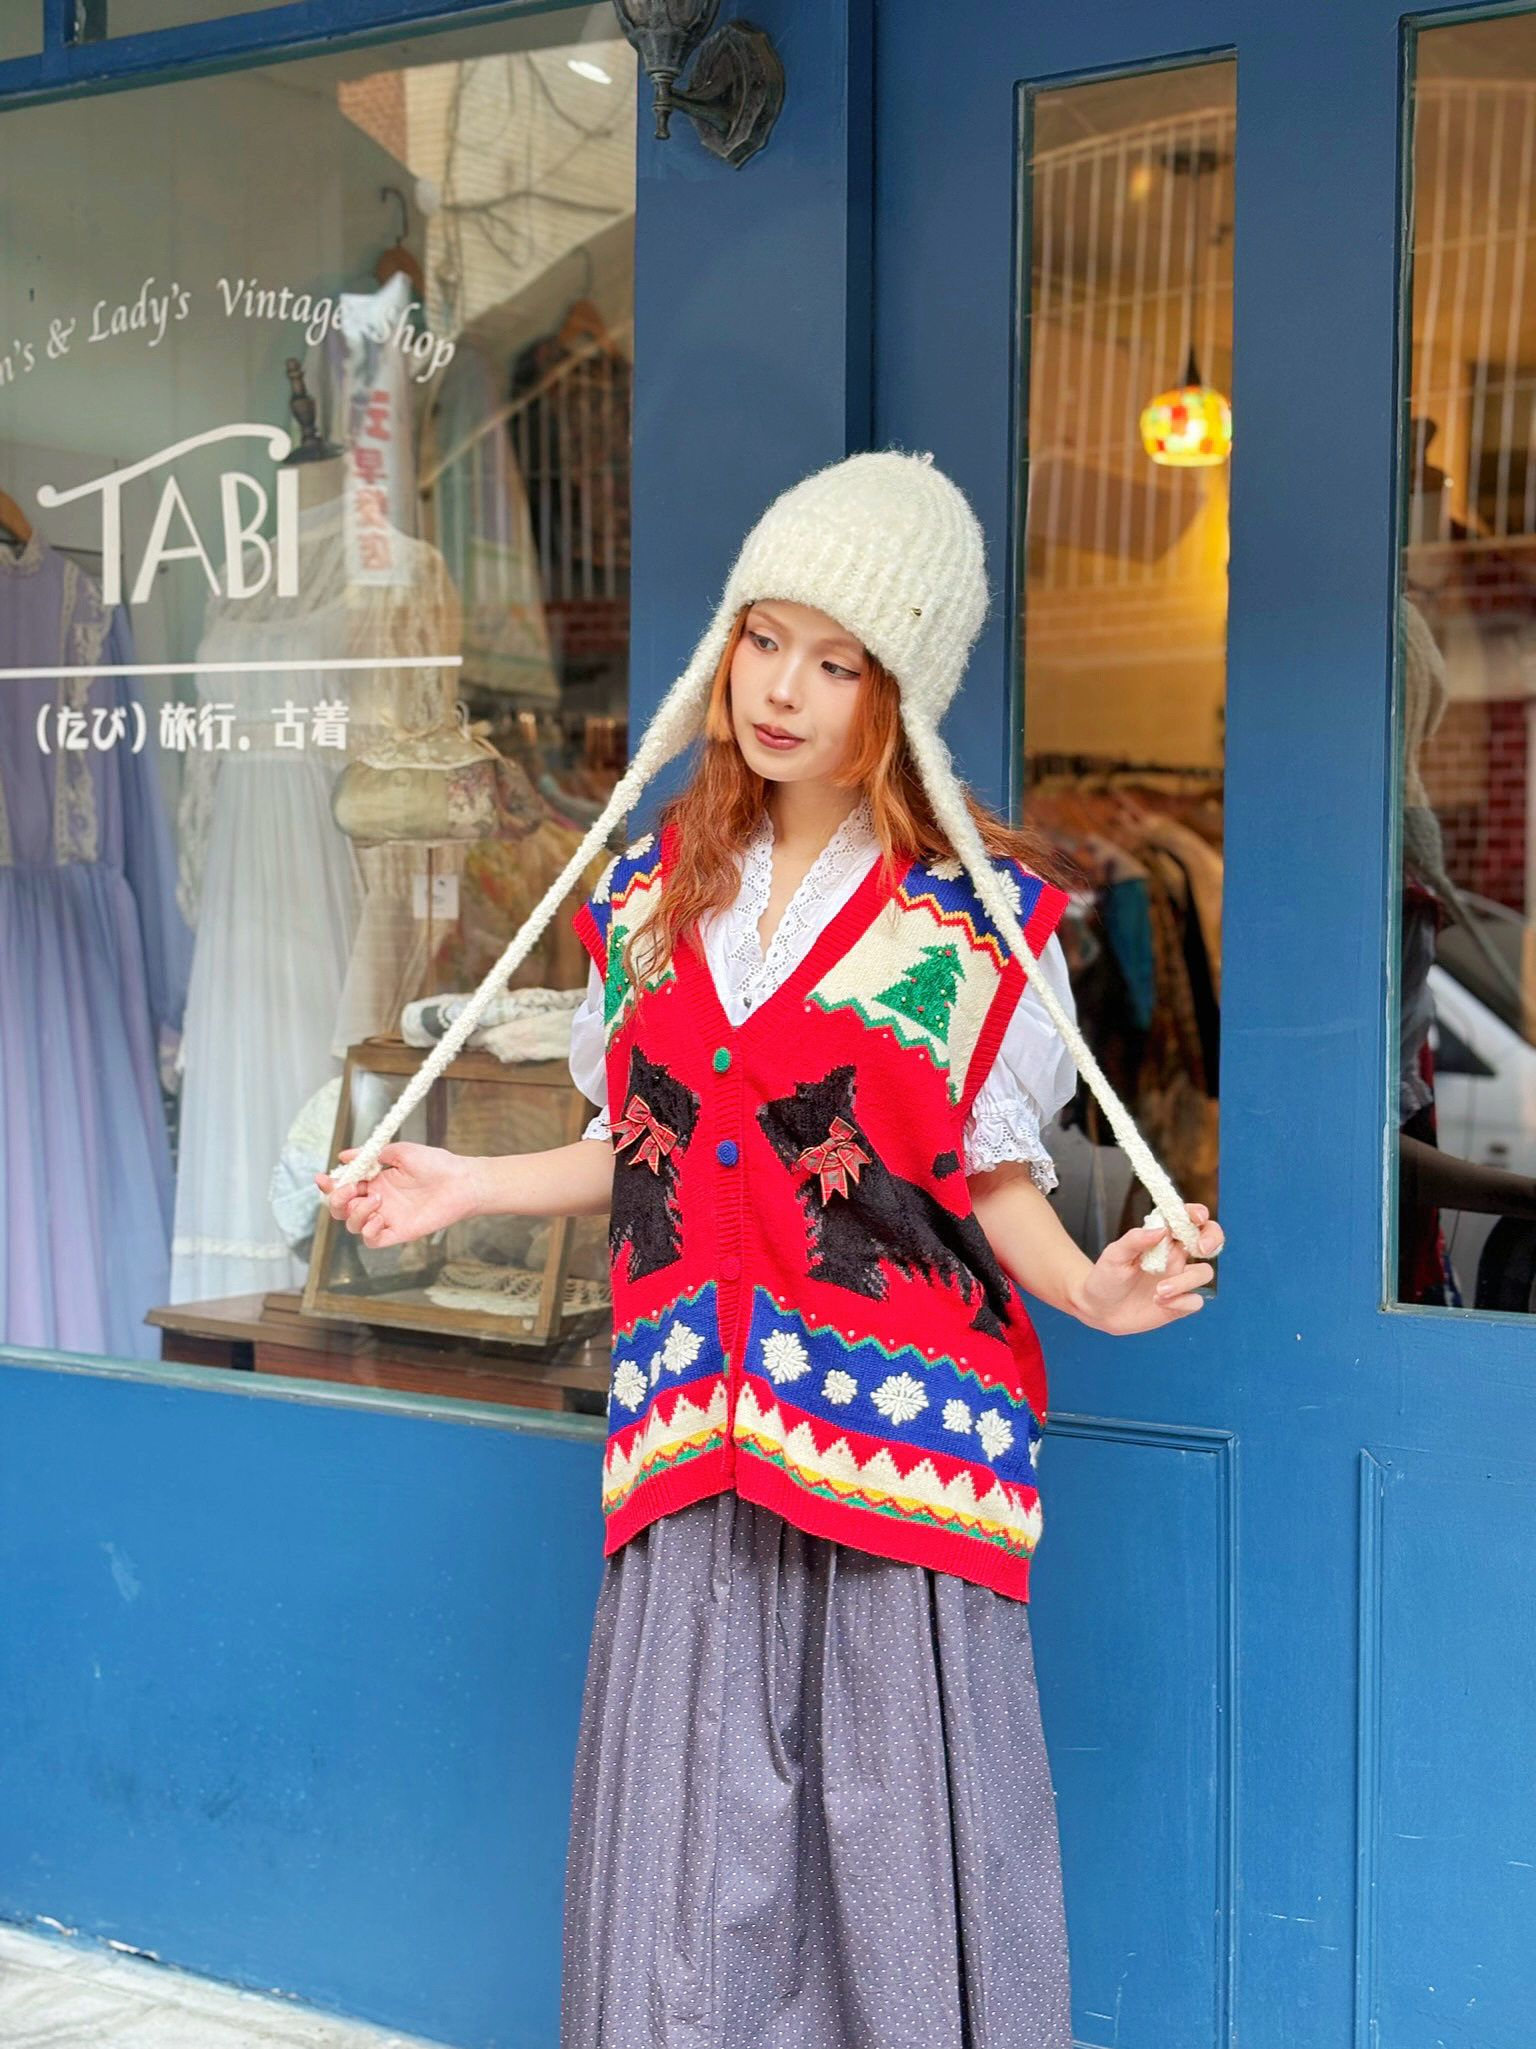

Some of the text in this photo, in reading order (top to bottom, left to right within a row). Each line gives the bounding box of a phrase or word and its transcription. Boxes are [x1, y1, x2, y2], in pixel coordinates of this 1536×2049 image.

[46, 317, 76, 359] &
[88, 277, 191, 347] Lady's
[217, 278, 351, 346] Vintage
[37, 423, 299, 606] TABI
[271, 699, 350, 750] 古着
